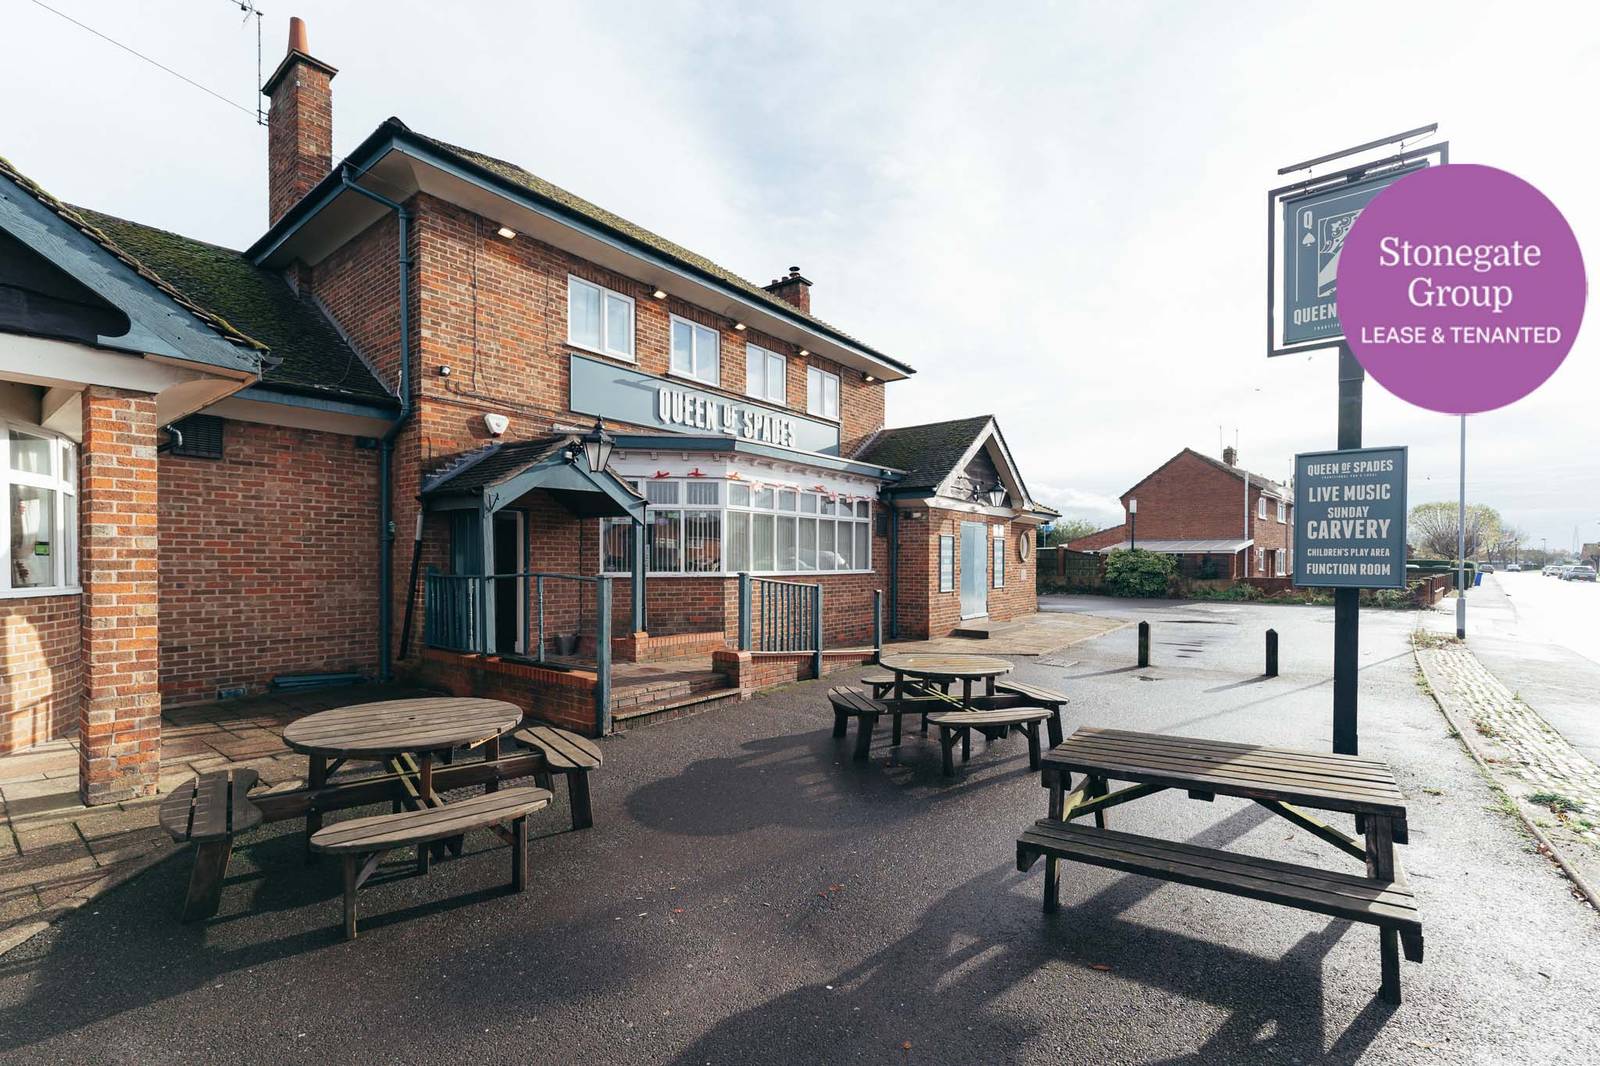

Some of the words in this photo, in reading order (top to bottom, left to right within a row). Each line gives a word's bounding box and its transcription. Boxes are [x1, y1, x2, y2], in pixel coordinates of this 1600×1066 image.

[1303, 210, 1314, 230] Q
[1293, 303, 1337, 326] QUEEN
[659, 387, 718, 431] QUEEN
[723, 403, 739, 434] OF
[743, 410, 797, 448] SPADES
[1307, 463, 1339, 477] QUEEN
[1341, 462, 1352, 474] OF
[1353, 459, 1393, 474] SPADES
[1308, 486, 1340, 503] LIVE
[1344, 483, 1391, 502] MUSIC
[1327, 506, 1369, 519] SUNDAY
[1307, 518, 1391, 540] CARVERY
[1307, 548, 1349, 557] CHILDREN'S
[1350, 548, 1369, 557] PLAY
[1370, 548, 1390, 557] AREA
[1306, 563, 1357, 576] FUNCTION
[1360, 563, 1391, 576] ROOM
